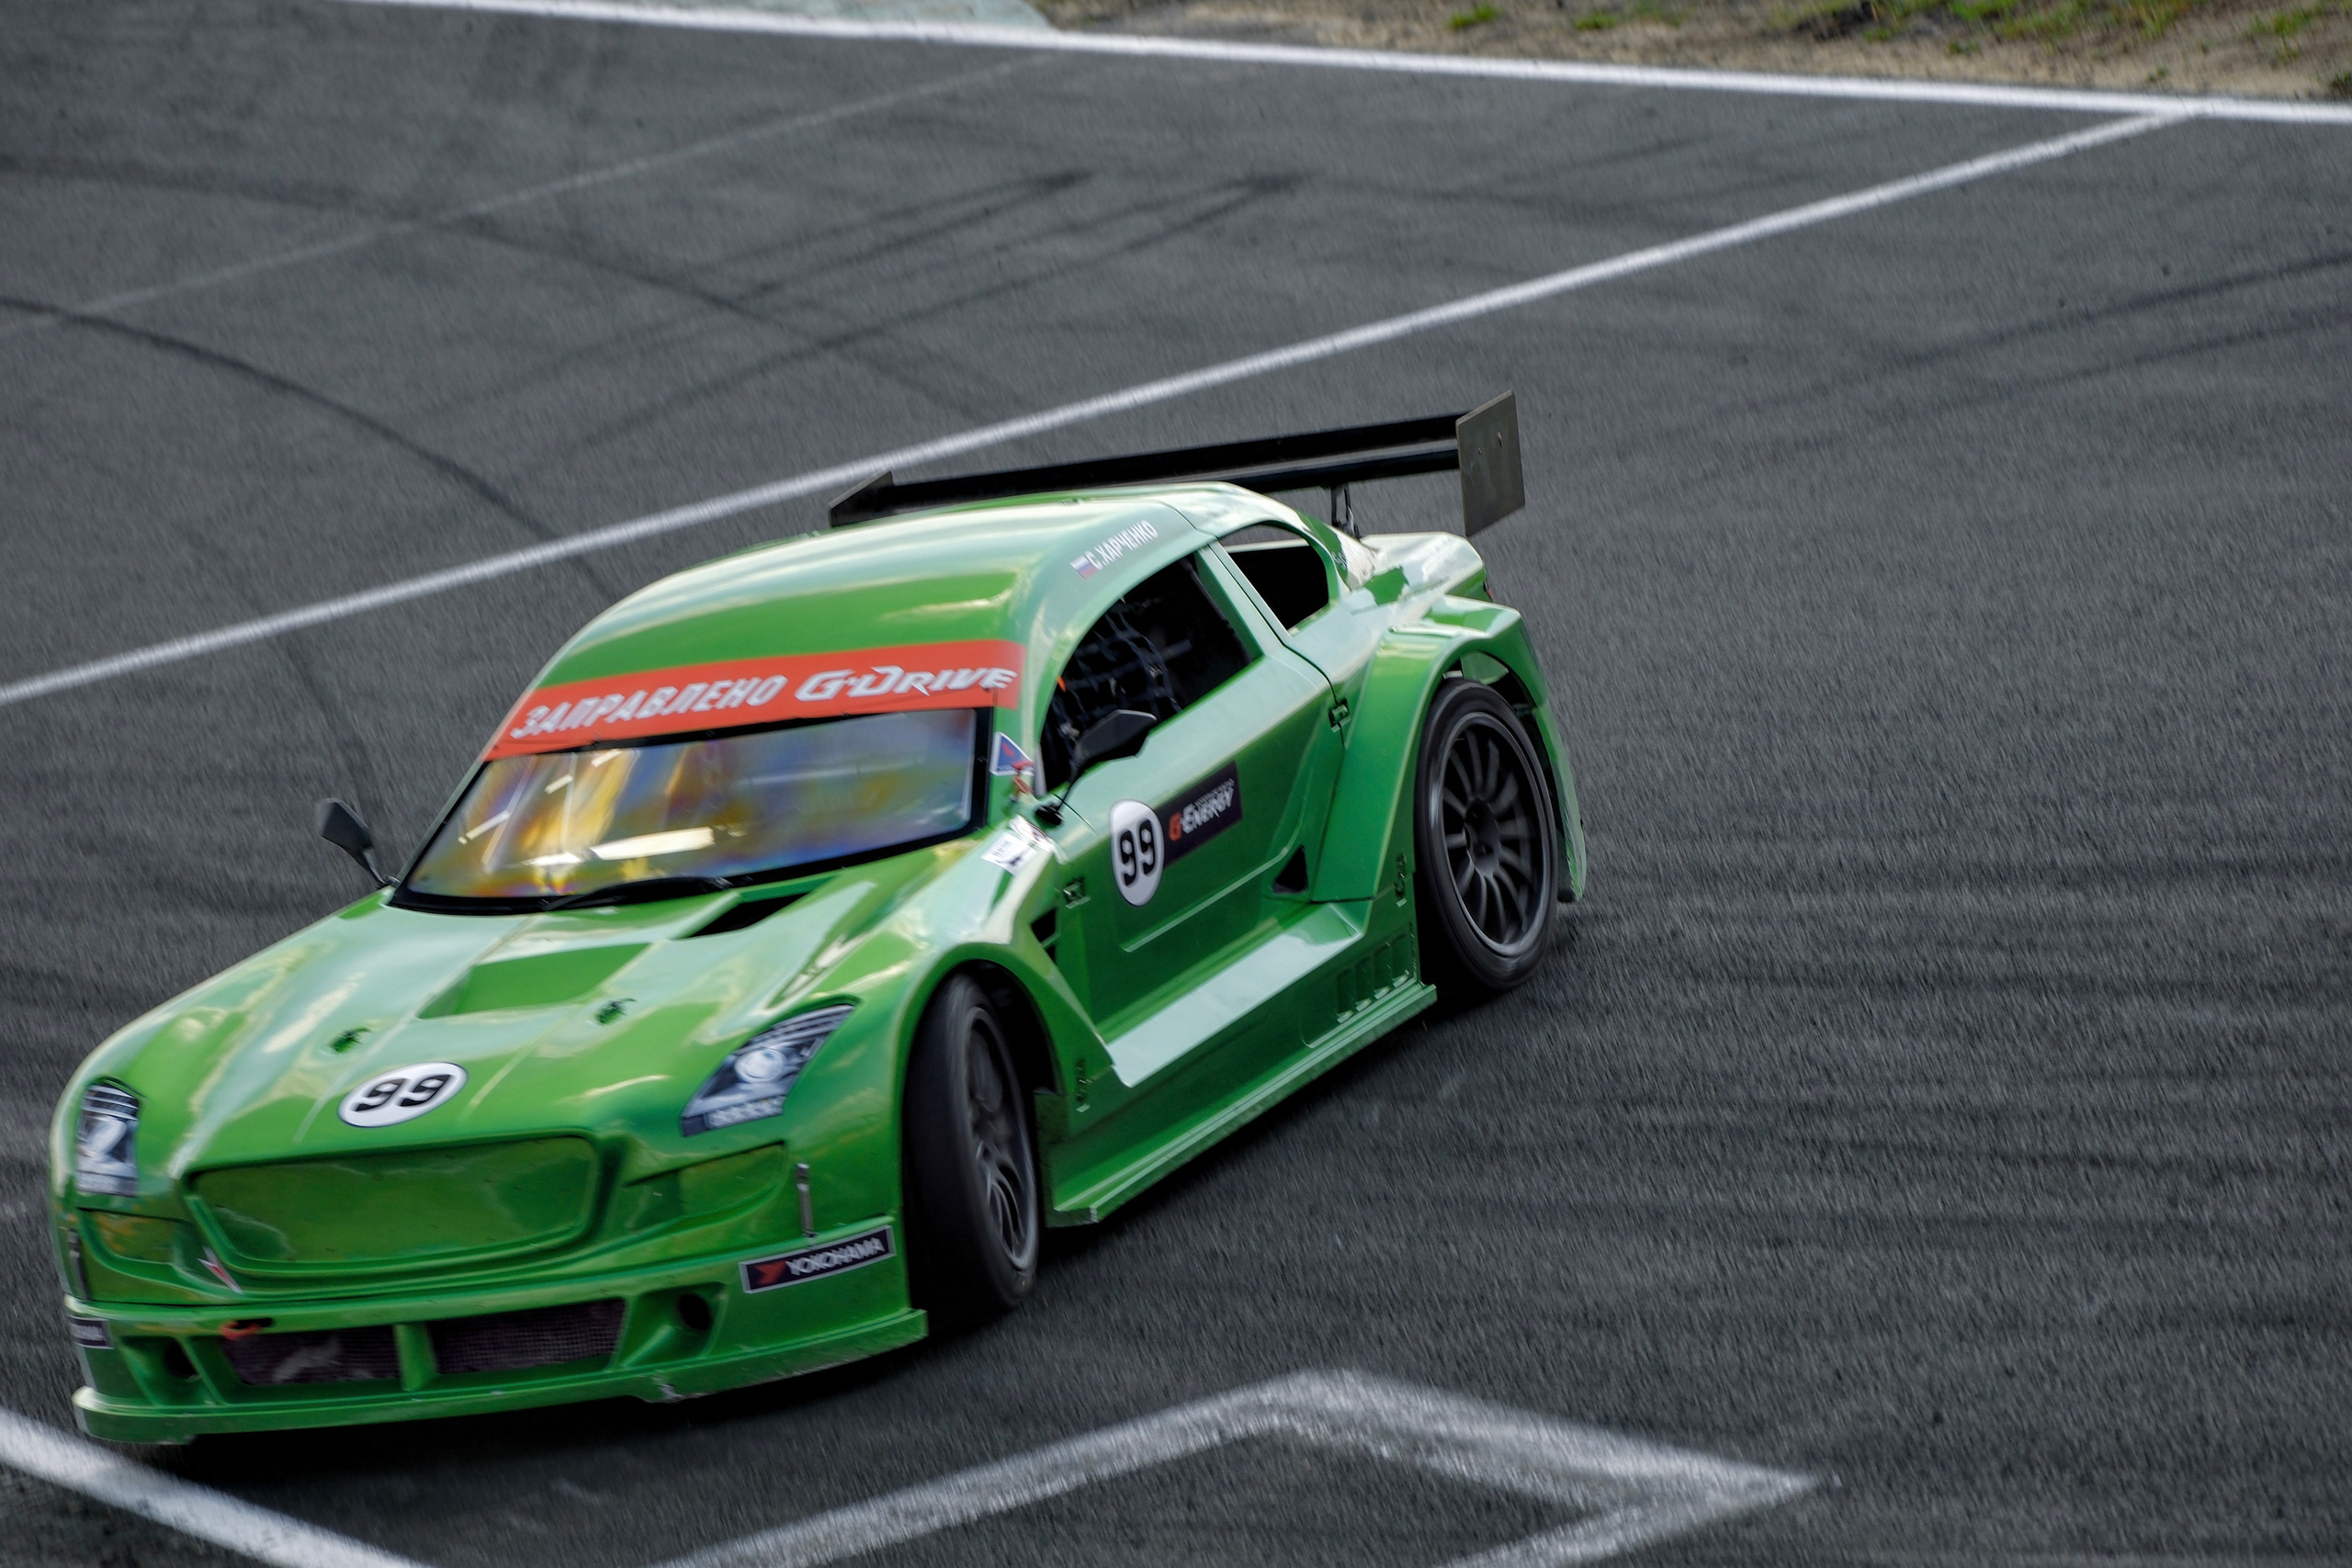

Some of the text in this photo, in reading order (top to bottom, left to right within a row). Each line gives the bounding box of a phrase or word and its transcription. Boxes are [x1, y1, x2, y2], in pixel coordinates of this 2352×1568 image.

[509, 674, 788, 739] ЗАПРАВЛЕНО
[1117, 818, 1156, 886] 99
[354, 1074, 455, 1112] 99
